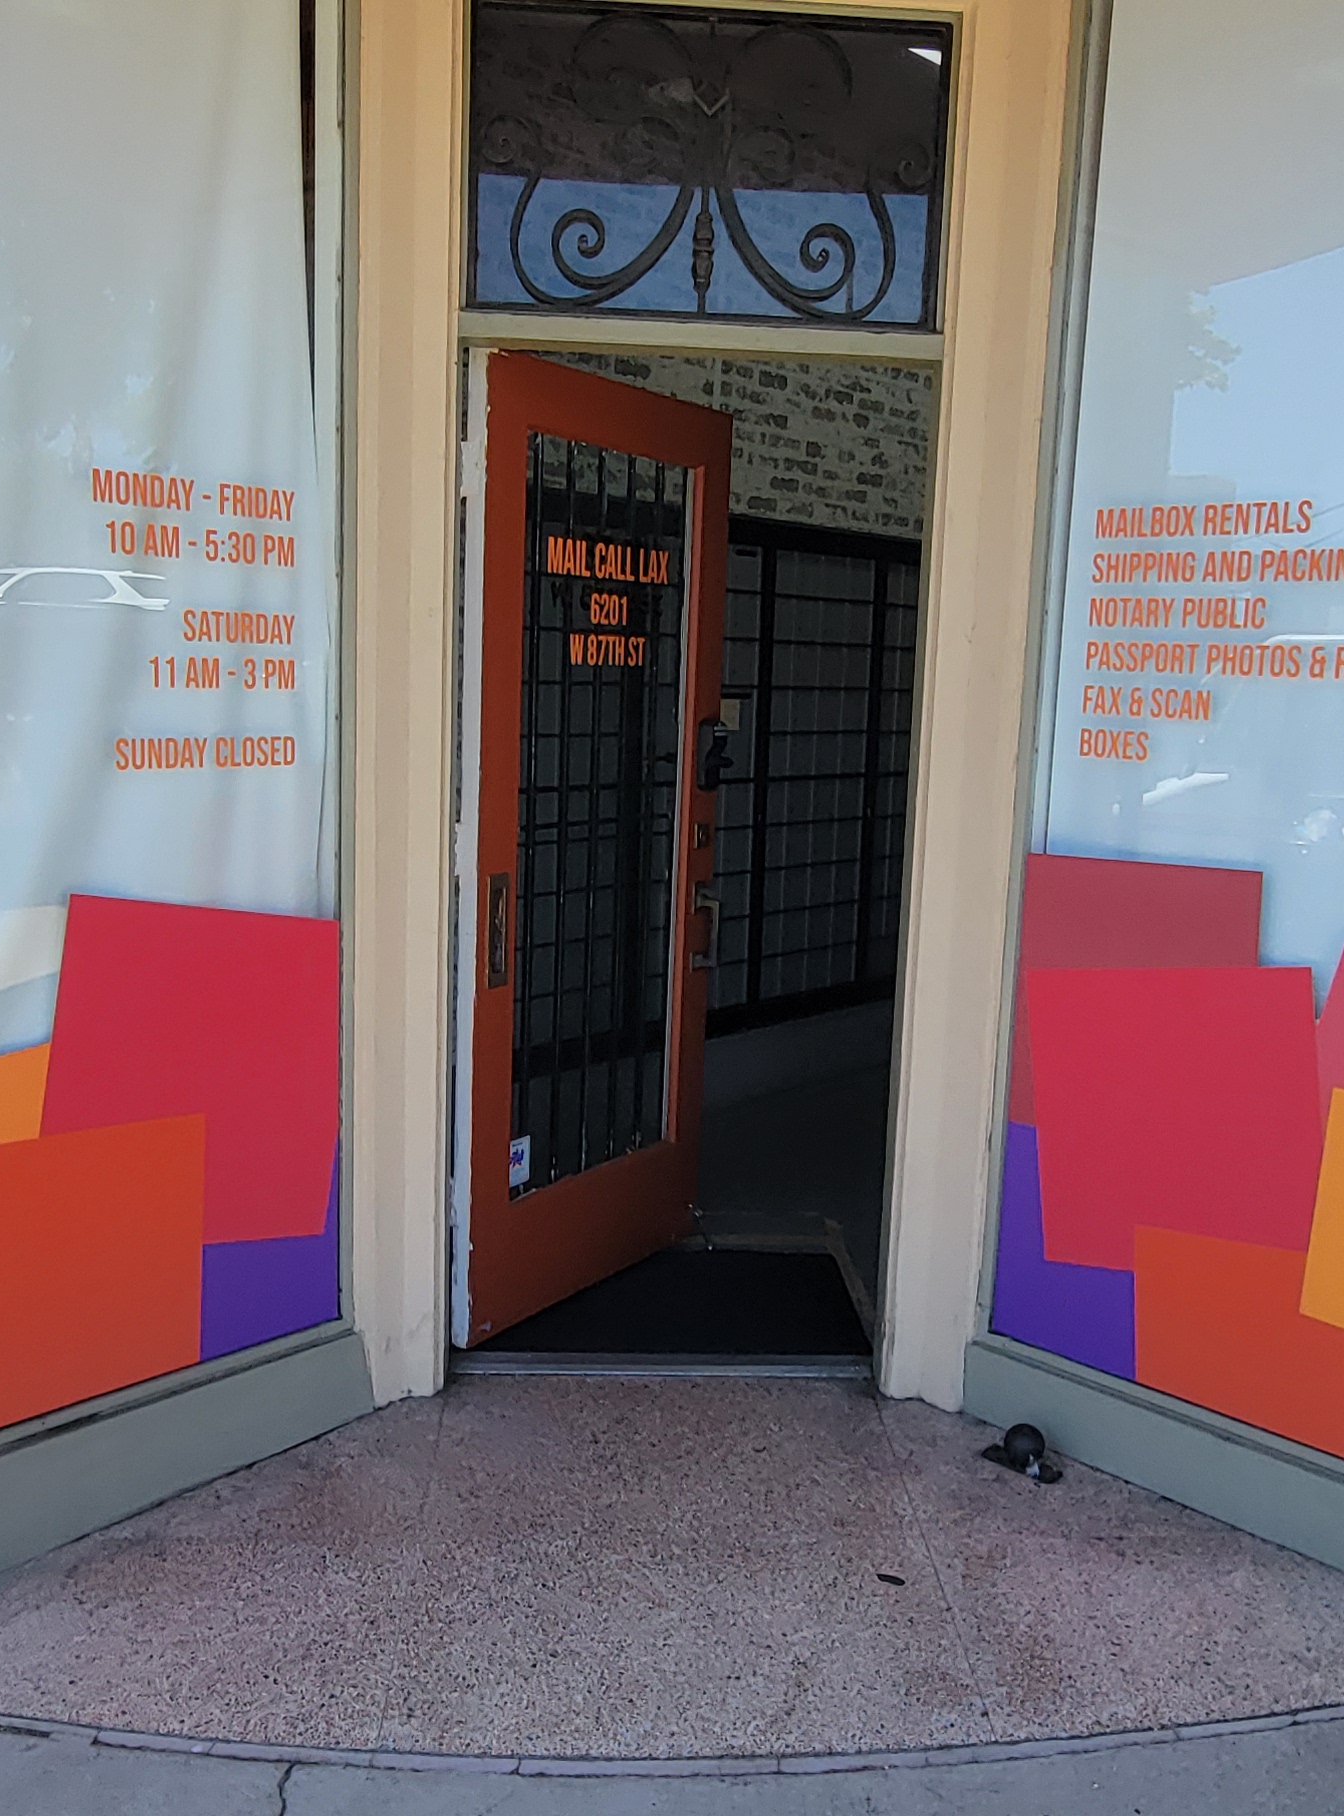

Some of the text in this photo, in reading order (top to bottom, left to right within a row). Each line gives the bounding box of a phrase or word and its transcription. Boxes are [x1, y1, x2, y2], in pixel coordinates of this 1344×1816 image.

[92, 467, 194, 511] MONDAY
[219, 483, 295, 522] FRIDAY
[1095, 500, 1313, 539] MAILBOX RENTALS
[106, 520, 135, 555] 10
[144, 524, 180, 558] AM
[205, 528, 255, 564] 5:30
[263, 534, 295, 567] PM
[547, 536, 669, 585] MAIL CALL LAX
[1091, 551, 1196, 584] SHIPPING
[1202, 550, 1252, 583] AND
[183, 608, 295, 644] SATURDAY
[590, 593, 628, 626] 6201
[1088, 597, 1266, 629] NOTARY PUBLIC
[570, 633, 645, 667] W 87TH ST
[1085, 641, 1200, 674] PASSPORT
[1205, 644, 1302, 678] PHOTOS
[1309, 646, 1326, 679] &
[149, 656, 176, 689] 11
[185, 656, 219, 689] AM
[244, 658, 256, 689] 3
[263, 658, 295, 690] PM
[1082, 685, 1211, 721] FAX & SCAN
[115, 736, 296, 771] SUNDAY CLOSED
[1079, 728, 1150, 761] BOXES
